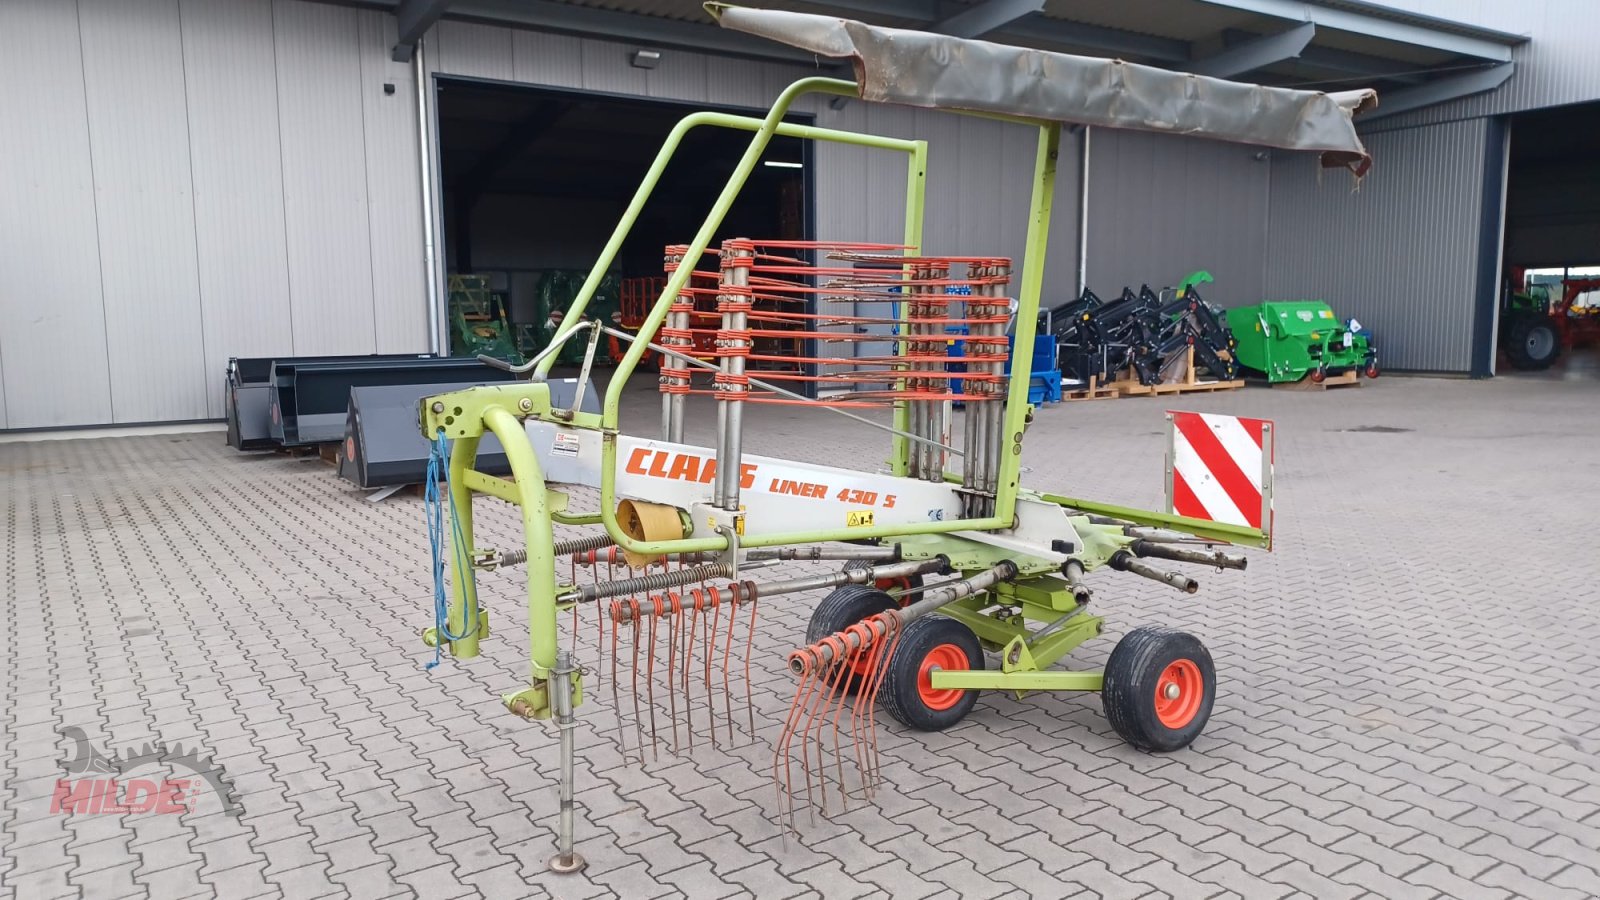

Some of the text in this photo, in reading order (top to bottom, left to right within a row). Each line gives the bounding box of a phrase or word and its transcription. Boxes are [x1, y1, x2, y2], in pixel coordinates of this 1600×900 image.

[769, 478, 828, 499] LINER
[837, 488, 878, 507] 430
[883, 494, 896, 509] S
